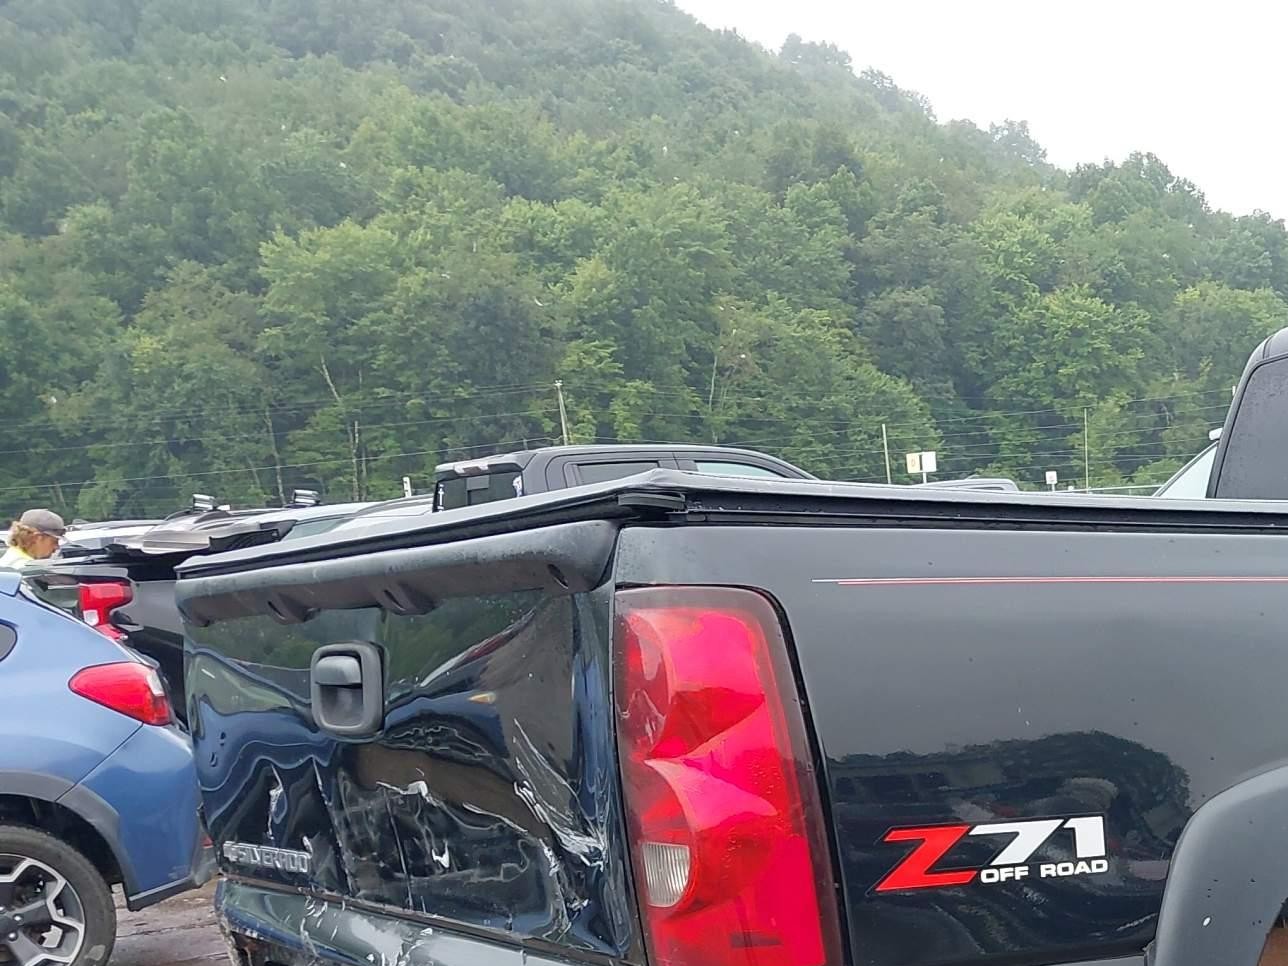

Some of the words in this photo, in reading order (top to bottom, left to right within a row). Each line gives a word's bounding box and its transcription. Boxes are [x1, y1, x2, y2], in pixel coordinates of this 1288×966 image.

[875, 815, 1106, 892] Z71
[980, 865, 1030, 884] OFF
[1039, 859, 1109, 879] ROAD
